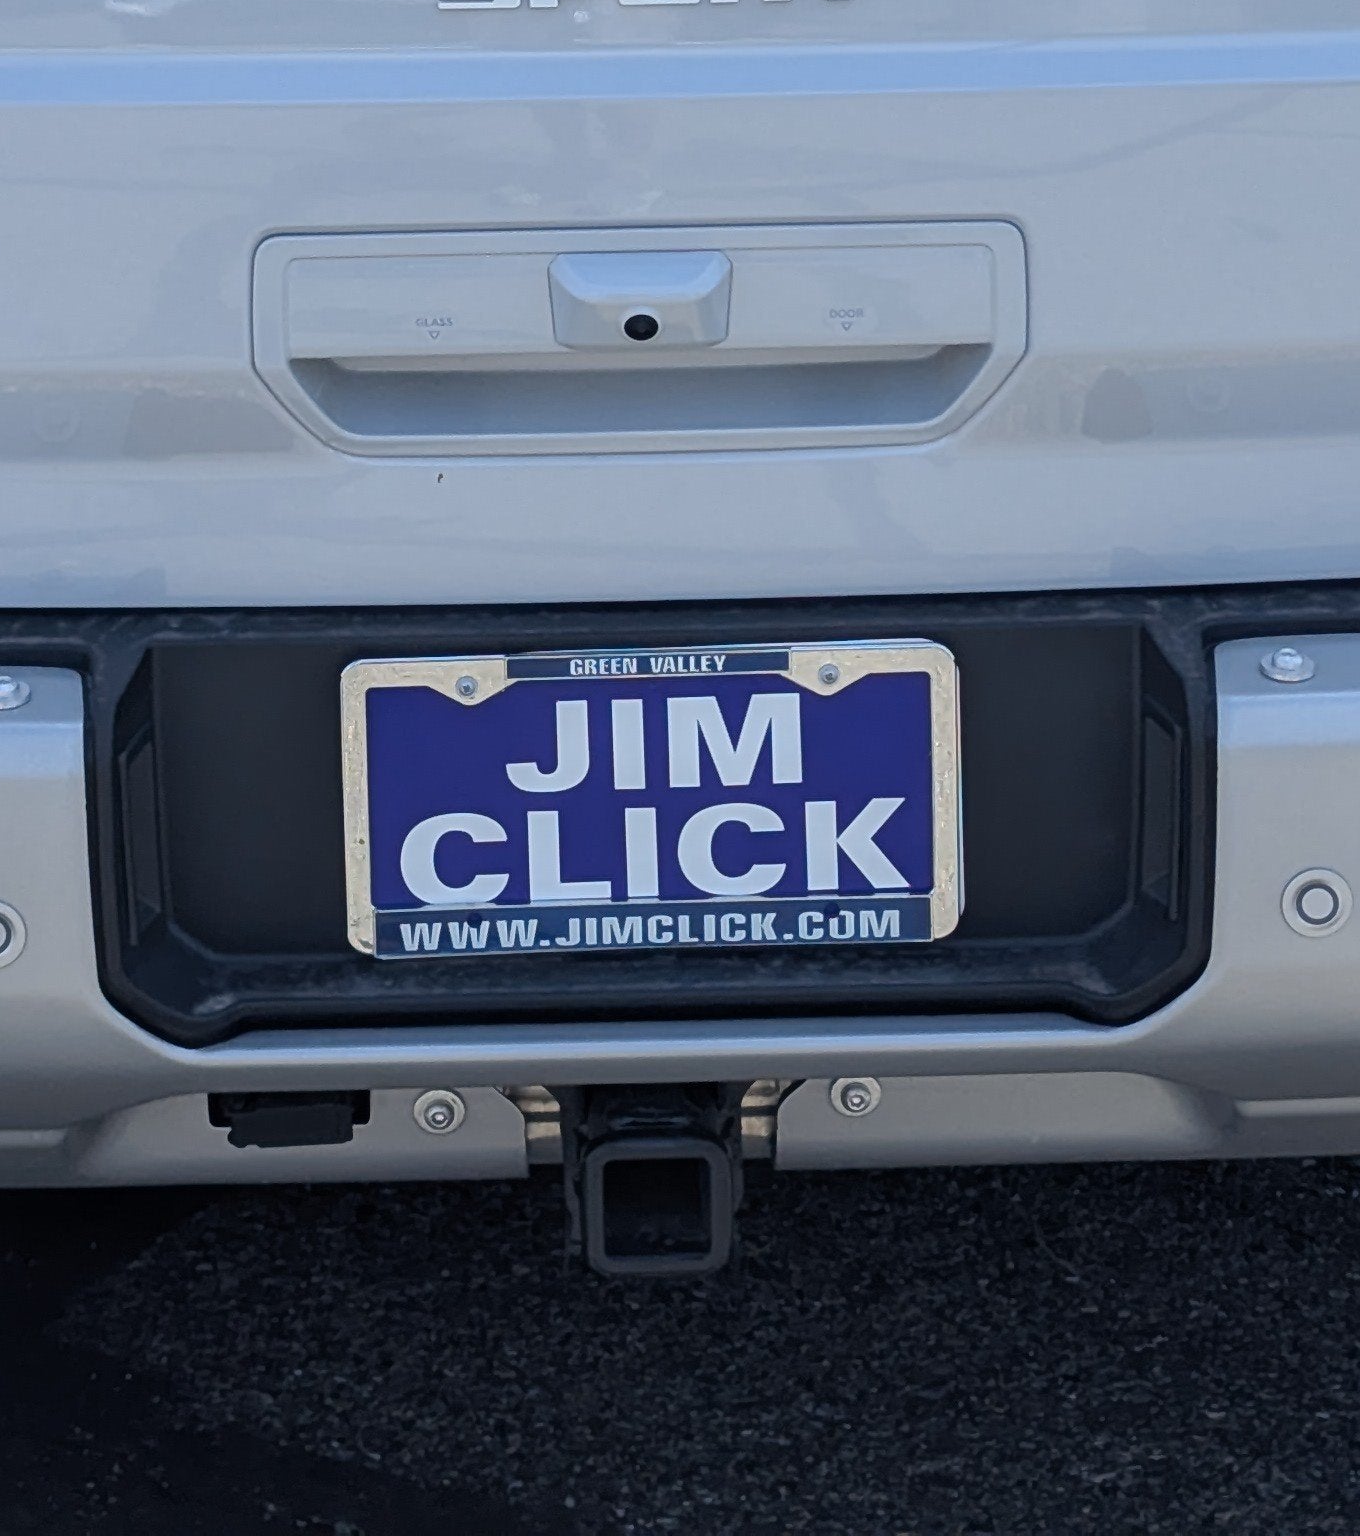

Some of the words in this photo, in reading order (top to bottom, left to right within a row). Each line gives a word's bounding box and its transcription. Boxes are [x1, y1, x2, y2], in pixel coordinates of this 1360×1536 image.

[569, 657, 638, 675] GREEN
[650, 654, 727, 674] VALLEY
[506, 692, 803, 793] JIM
[400, 797, 911, 905] CLICK
[400, 909, 902, 953] WWW.JIMCLICK.COM
